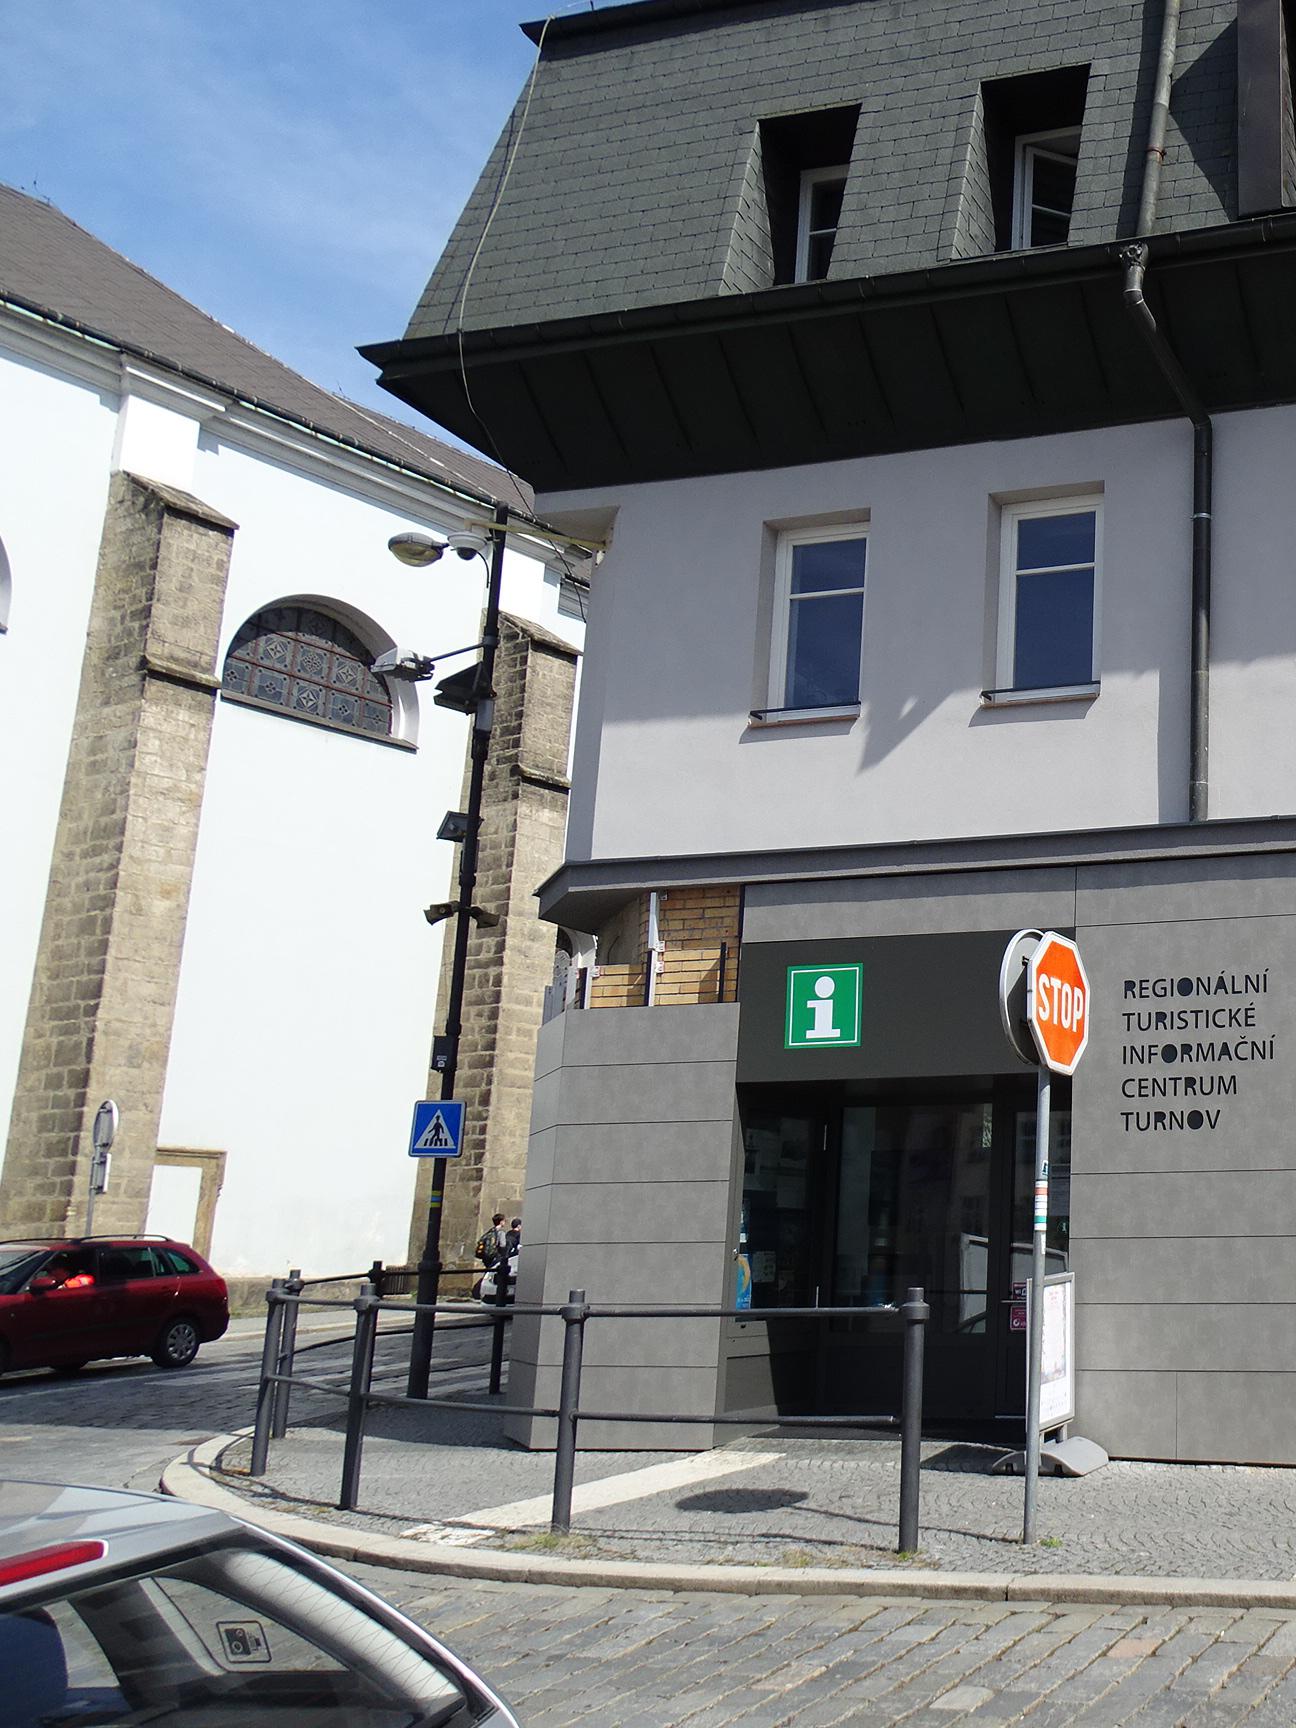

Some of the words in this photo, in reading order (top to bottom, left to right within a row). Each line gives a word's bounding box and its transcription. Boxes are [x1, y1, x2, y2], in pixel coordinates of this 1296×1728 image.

[1123, 967, 1270, 999] REGIONÁLNÍ
[1038, 973, 1084, 1033] STOP
[1121, 1001, 1257, 1032] TURISTICKÉ
[1122, 1034, 1276, 1065] INFORMAČNÍ
[1121, 1075, 1238, 1098] CENTRUM
[1120, 1109, 1221, 1132] TURNOV
